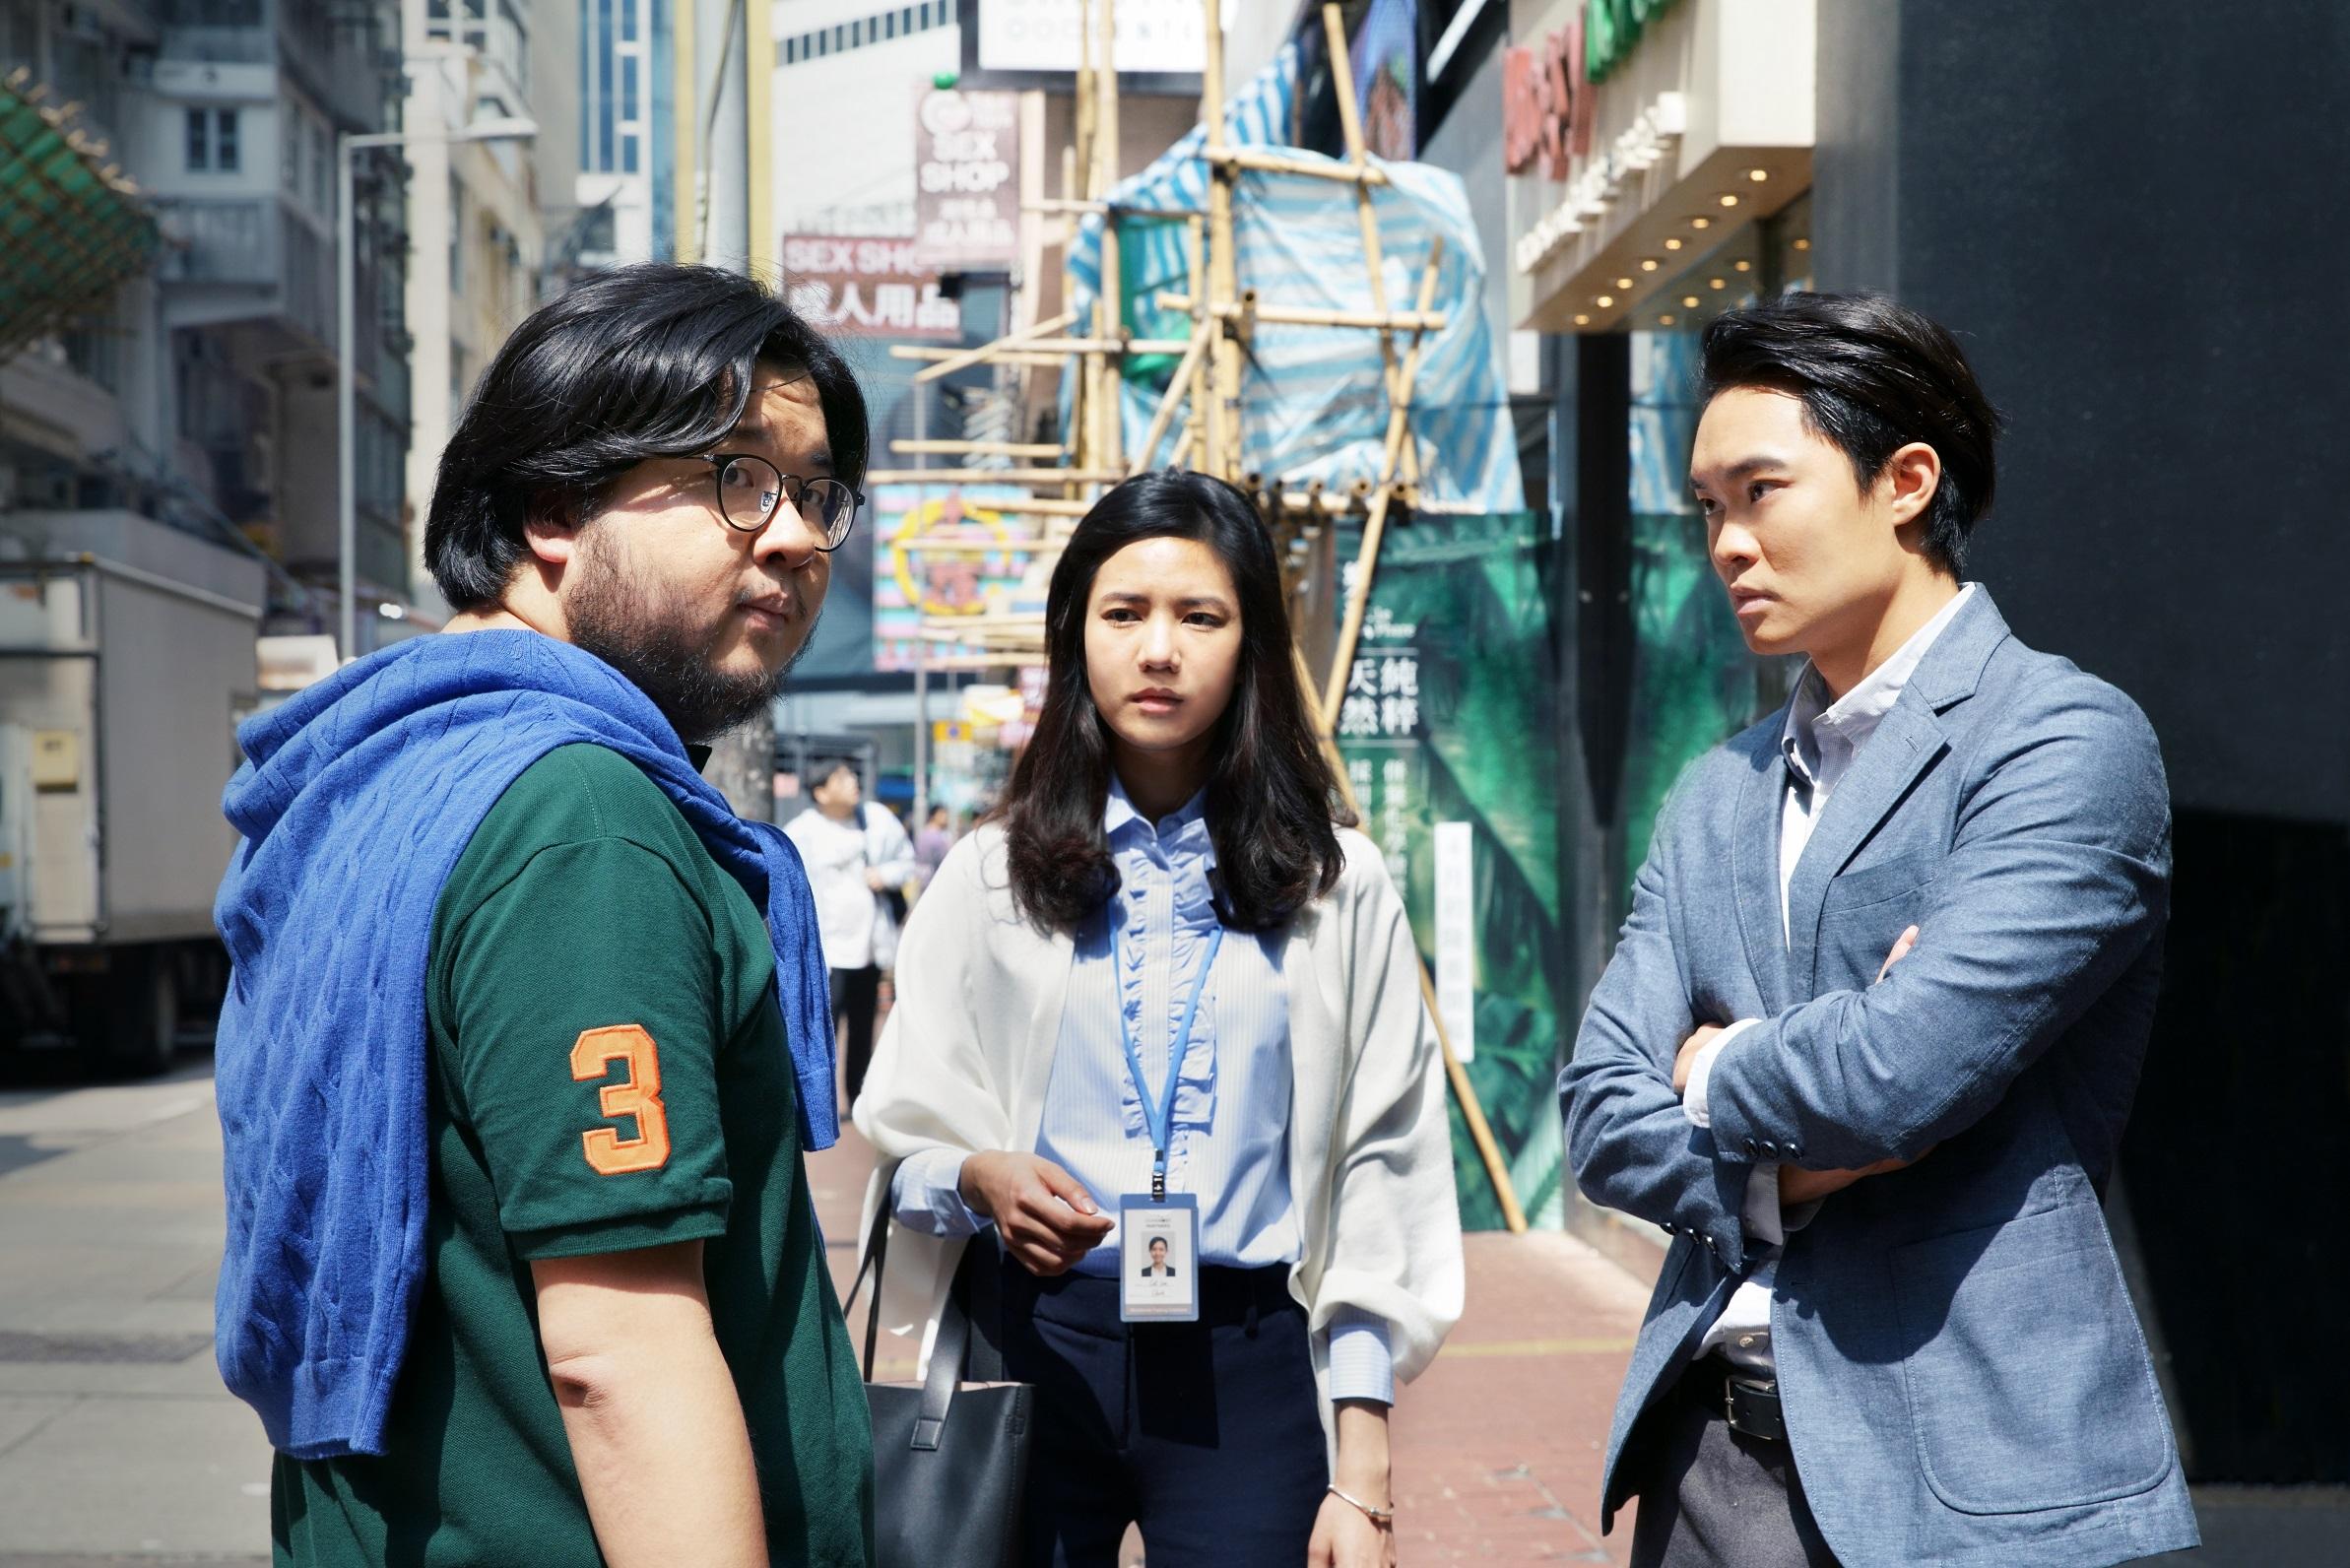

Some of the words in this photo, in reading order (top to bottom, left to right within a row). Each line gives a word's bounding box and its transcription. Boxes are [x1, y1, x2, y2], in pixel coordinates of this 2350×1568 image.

[933, 130, 998, 162] SEX
[921, 162, 1010, 192] SHOP
[786, 239, 855, 275] SEX
[856, 241, 924, 278] SH
[570, 1023, 672, 1176] 3
